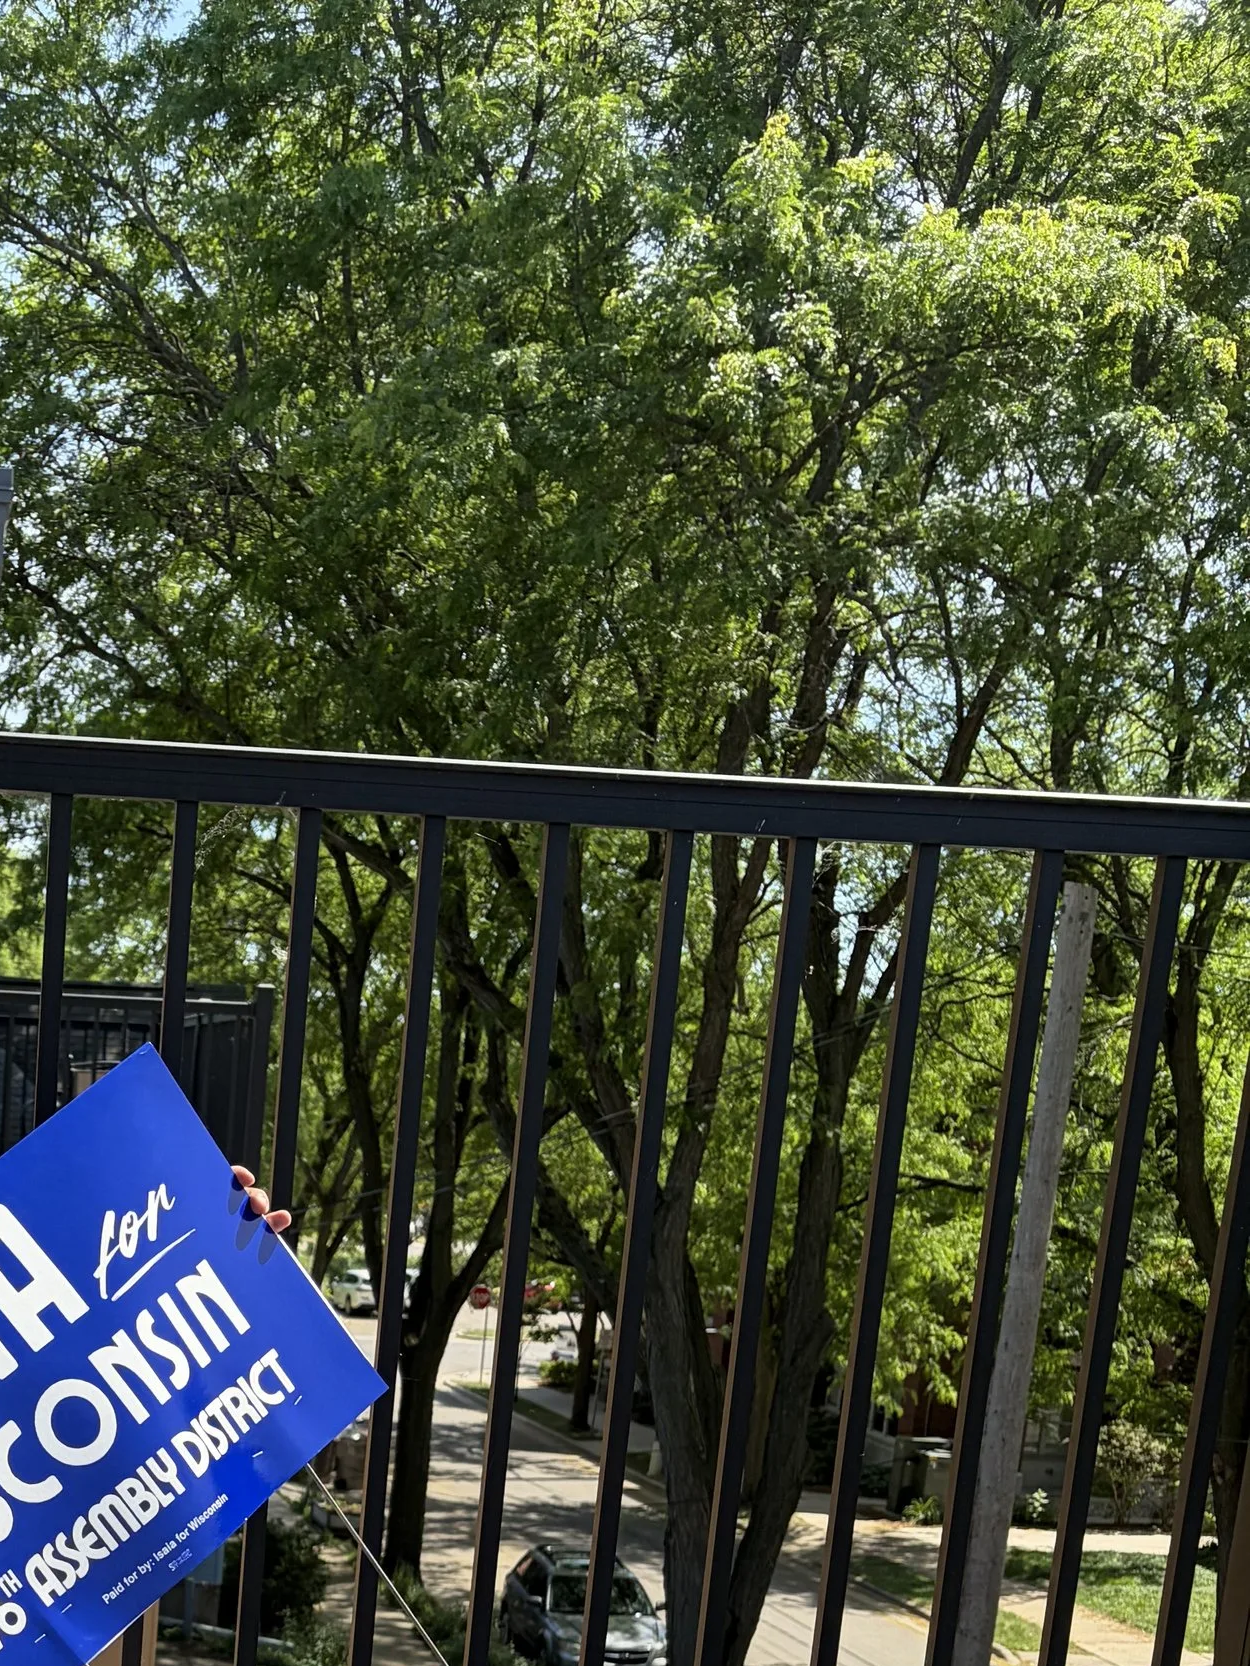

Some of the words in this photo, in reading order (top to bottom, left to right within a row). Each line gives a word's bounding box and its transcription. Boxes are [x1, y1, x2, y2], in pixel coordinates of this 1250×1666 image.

[93, 1183, 175, 1299] for
[25, 1448, 185, 1607] ASSEMBLY
[171, 1348, 296, 1478] DISTRICT
[102, 1583, 125, 1604] Paid
[123, 1572, 138, 1586] for
[137, 1559, 155, 1575] by:
[153, 1541, 177, 1561] Isaia
[175, 1528, 190, 1543] for
[187, 1493, 228, 1531] Wisconsin
